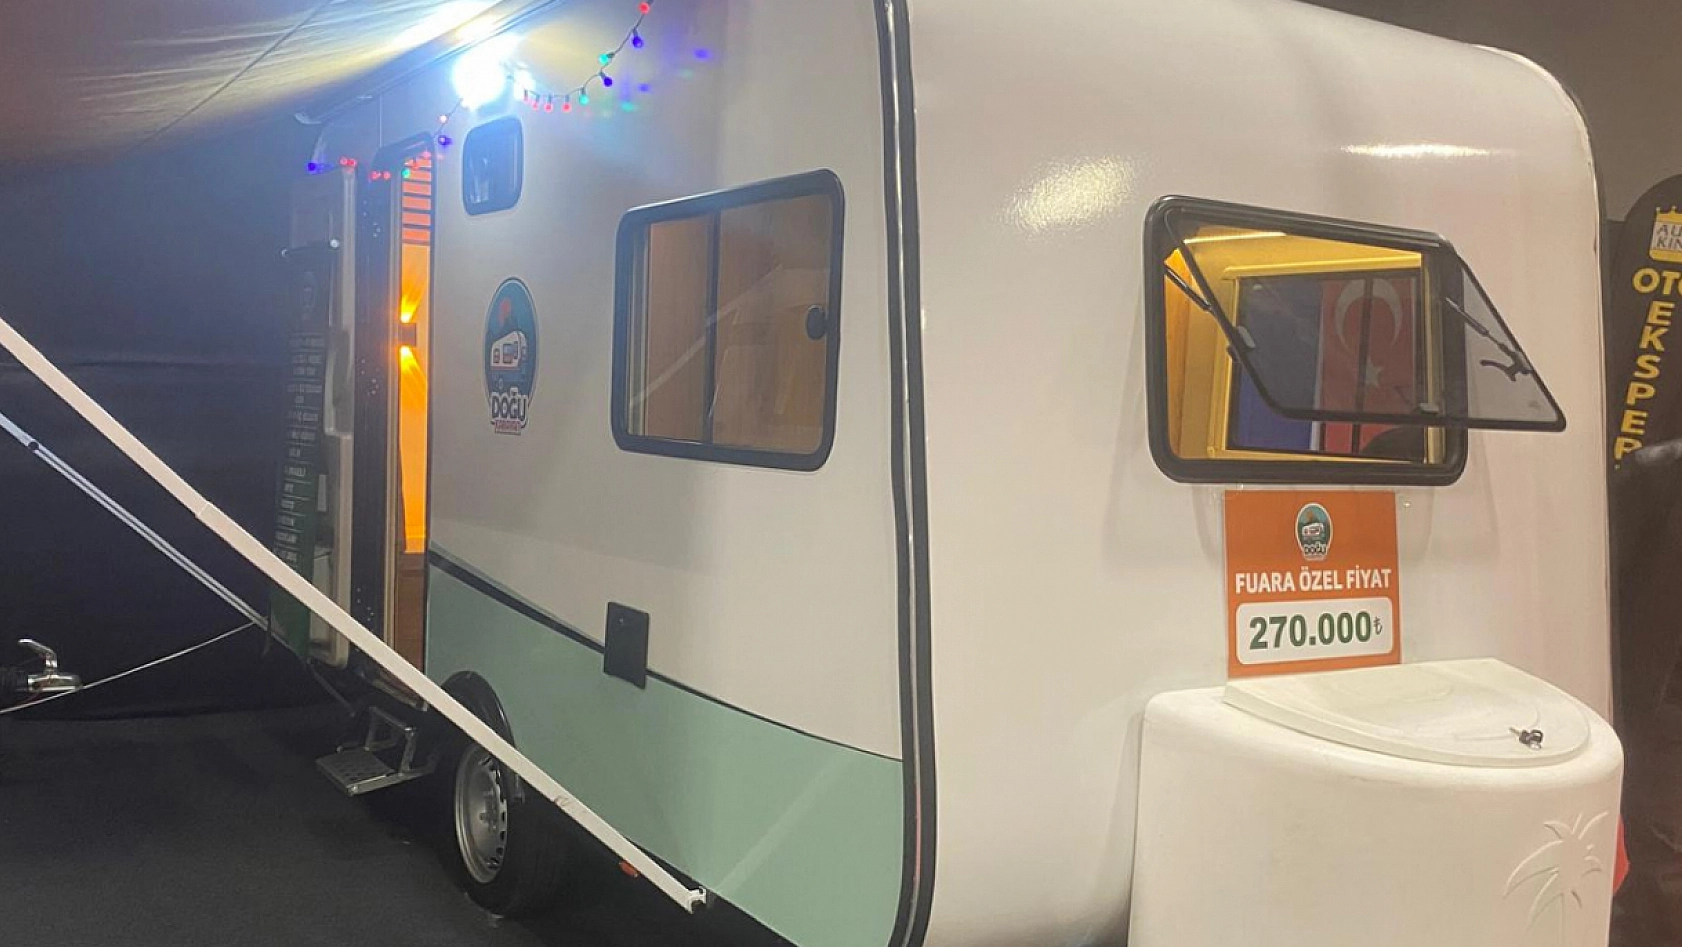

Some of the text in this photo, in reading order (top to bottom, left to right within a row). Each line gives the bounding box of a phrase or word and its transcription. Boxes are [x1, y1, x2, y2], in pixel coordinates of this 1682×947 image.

[1632, 267, 1682, 296] OT
[491, 391, 527, 422] DOĞU
[1235, 565, 1392, 595] FUARA ÖZEL FİYAT
